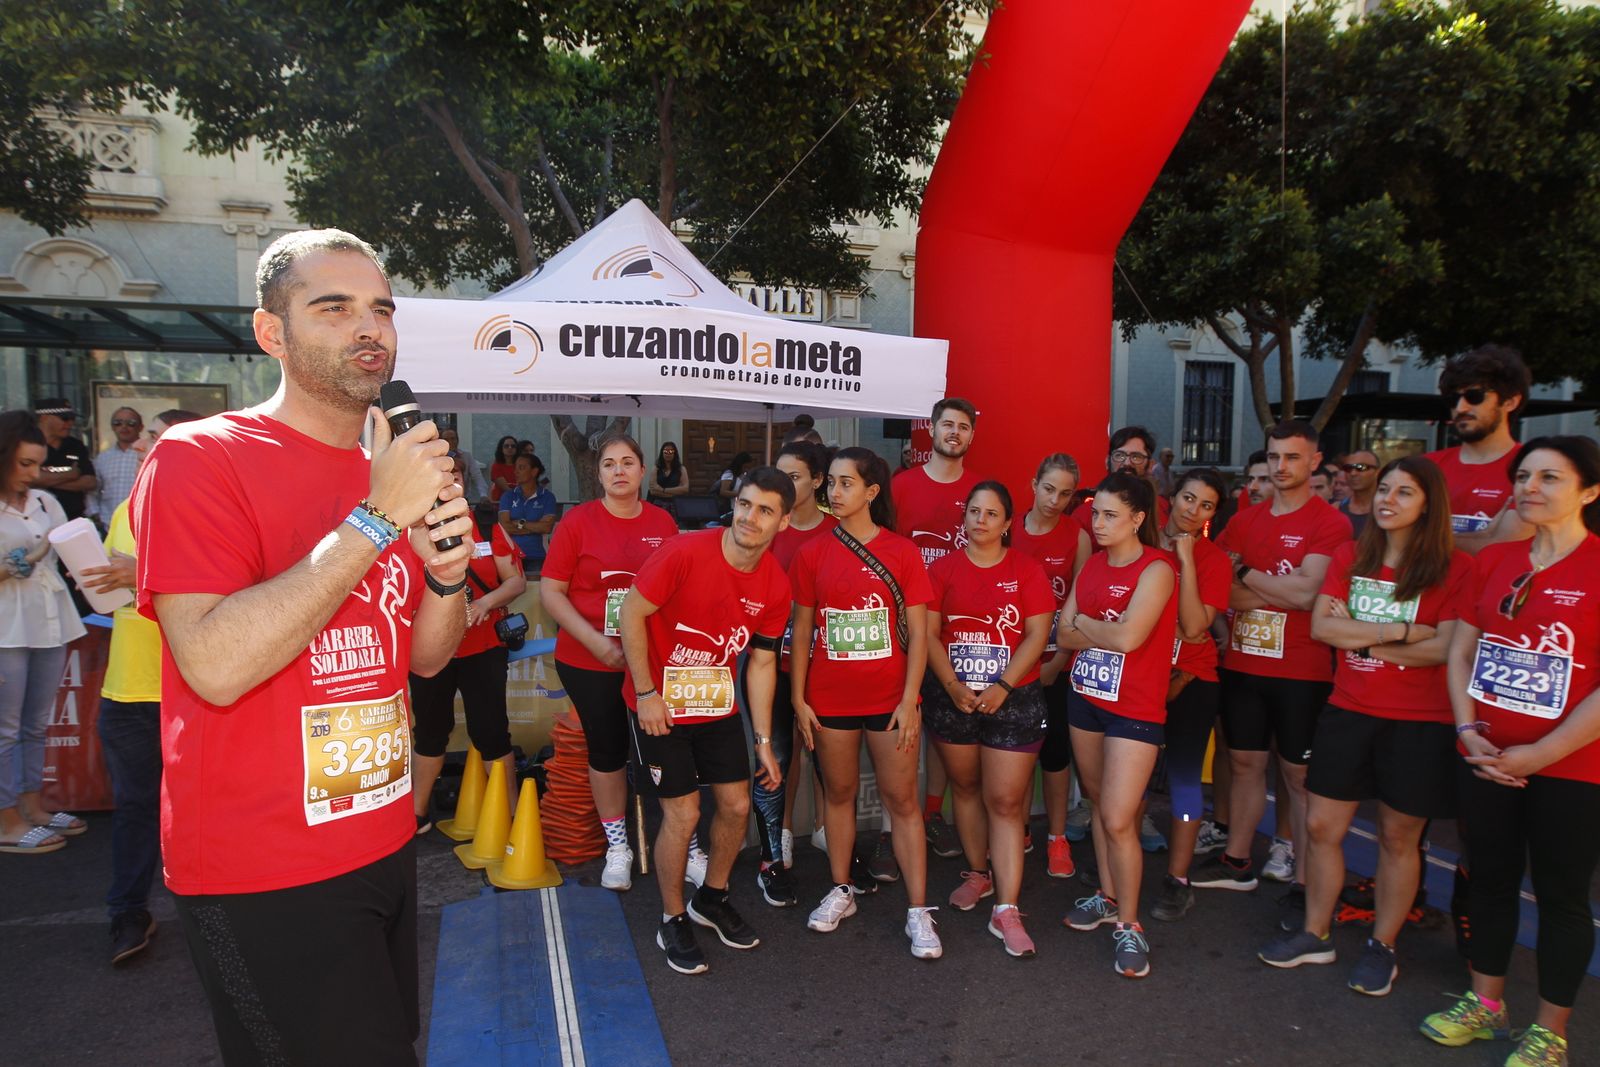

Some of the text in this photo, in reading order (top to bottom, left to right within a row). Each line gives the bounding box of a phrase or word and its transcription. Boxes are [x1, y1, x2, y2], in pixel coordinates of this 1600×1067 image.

[734, 287, 814, 314] ALLE
[559, 322, 862, 377] cruzandolameta
[660, 365, 862, 393] cronometraje deportivo
[362, 525, 384, 545] POCO
[918, 547, 951, 559] ARRERA
[1350, 593, 1402, 618] 1024
[309, 625, 383, 655] CARRERA
[832, 625, 880, 643] 1018
[954, 631, 991, 642] CARRERA
[1236, 621, 1272, 641] 3023
[310, 646, 386, 676] SOLIDARIA
[674, 643, 717, 663] CARRERA
[953, 658, 999, 675] 2009
[1074, 660, 1110, 683] 2016
[1481, 661, 1551, 693] 2223
[670, 683, 722, 700] 3017
[338, 707, 353, 731] 6
[310, 724, 331, 738] 2019
[322, 727, 404, 778] 3285
[360, 767, 390, 789] RAMÓN
